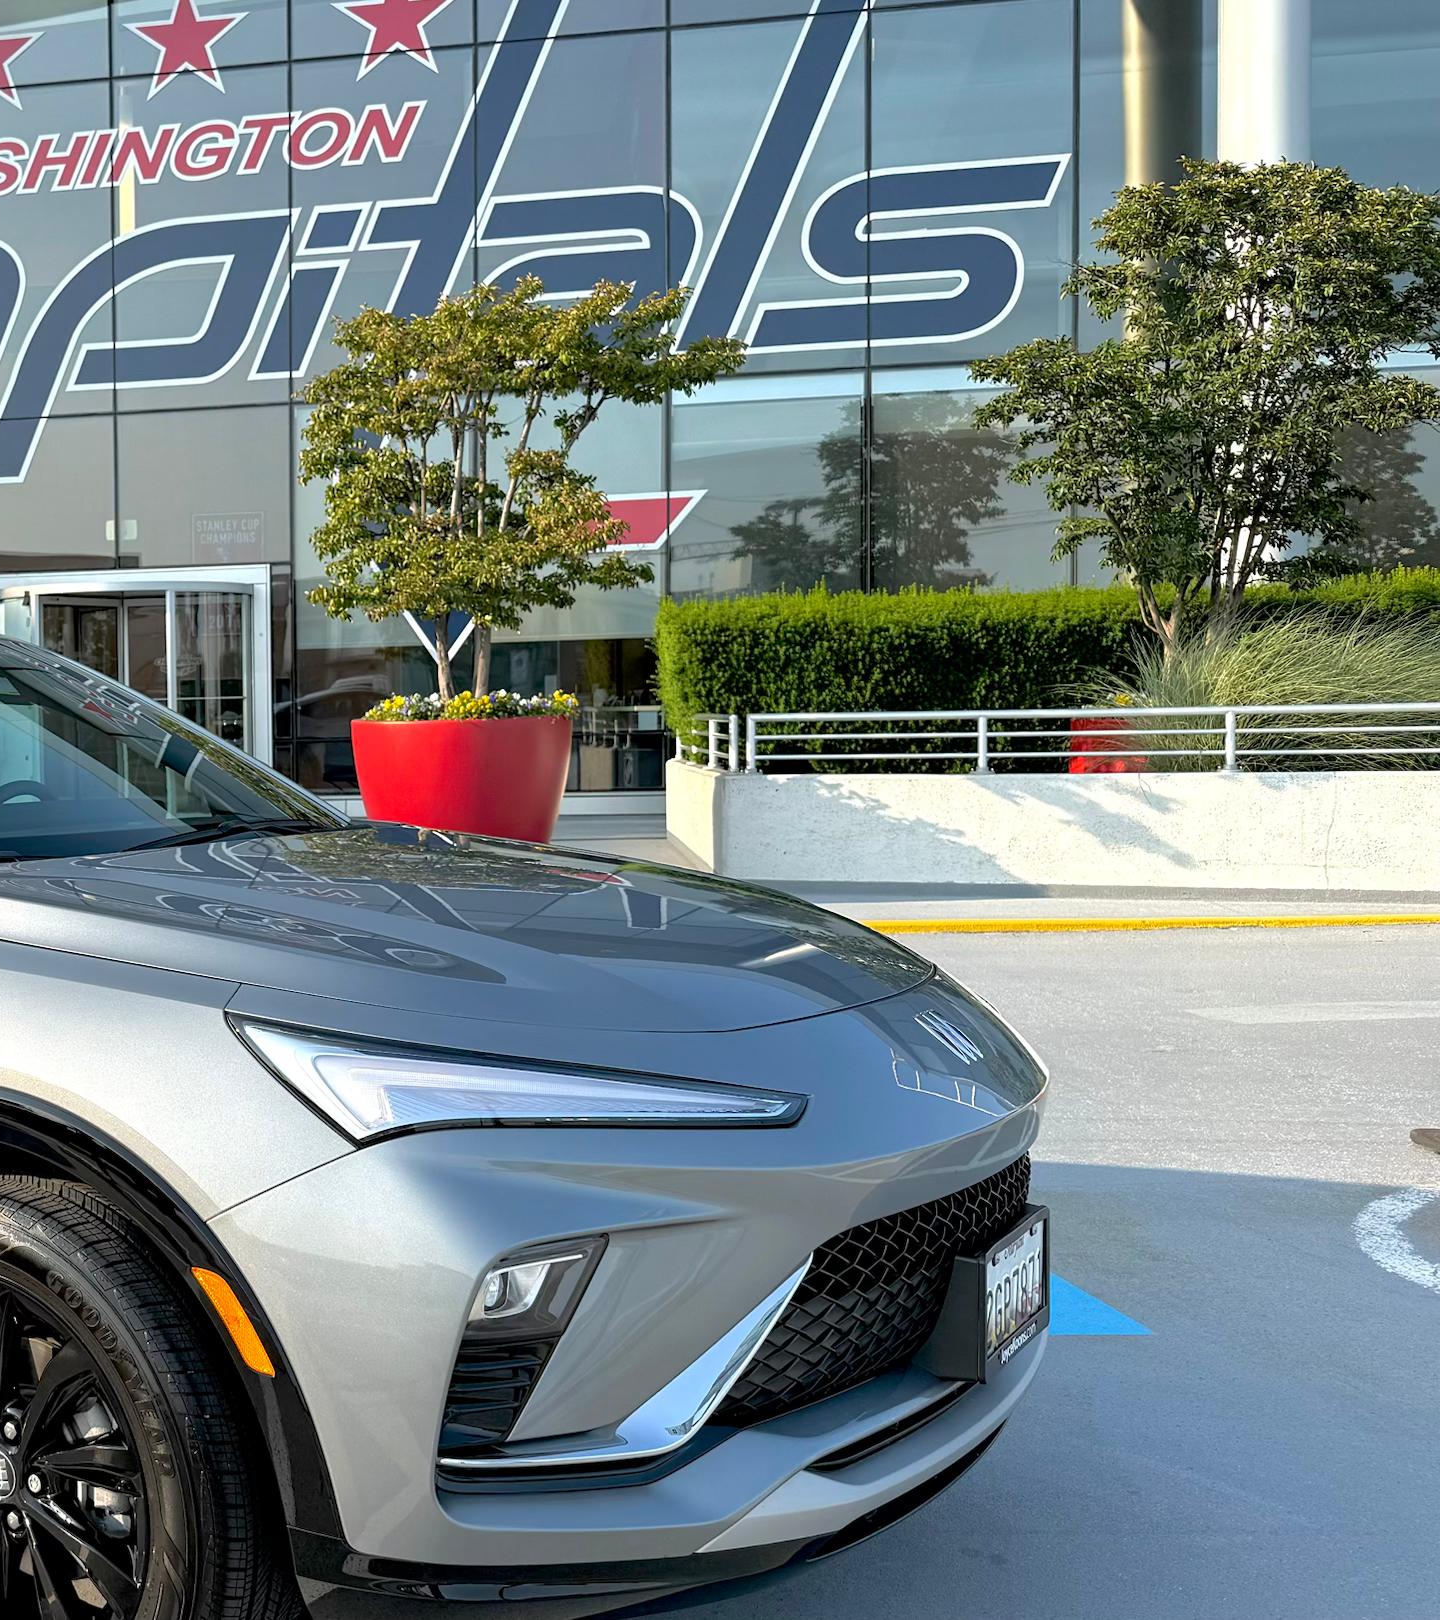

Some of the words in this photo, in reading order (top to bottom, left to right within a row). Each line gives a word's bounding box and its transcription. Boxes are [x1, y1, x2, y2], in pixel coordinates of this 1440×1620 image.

[195, 519, 238, 533] STANLEY
[241, 517, 260, 531] CUP
[200, 531, 257, 545] CHAMPIONS
[44, 1269, 176, 1478] GOODYEAR
